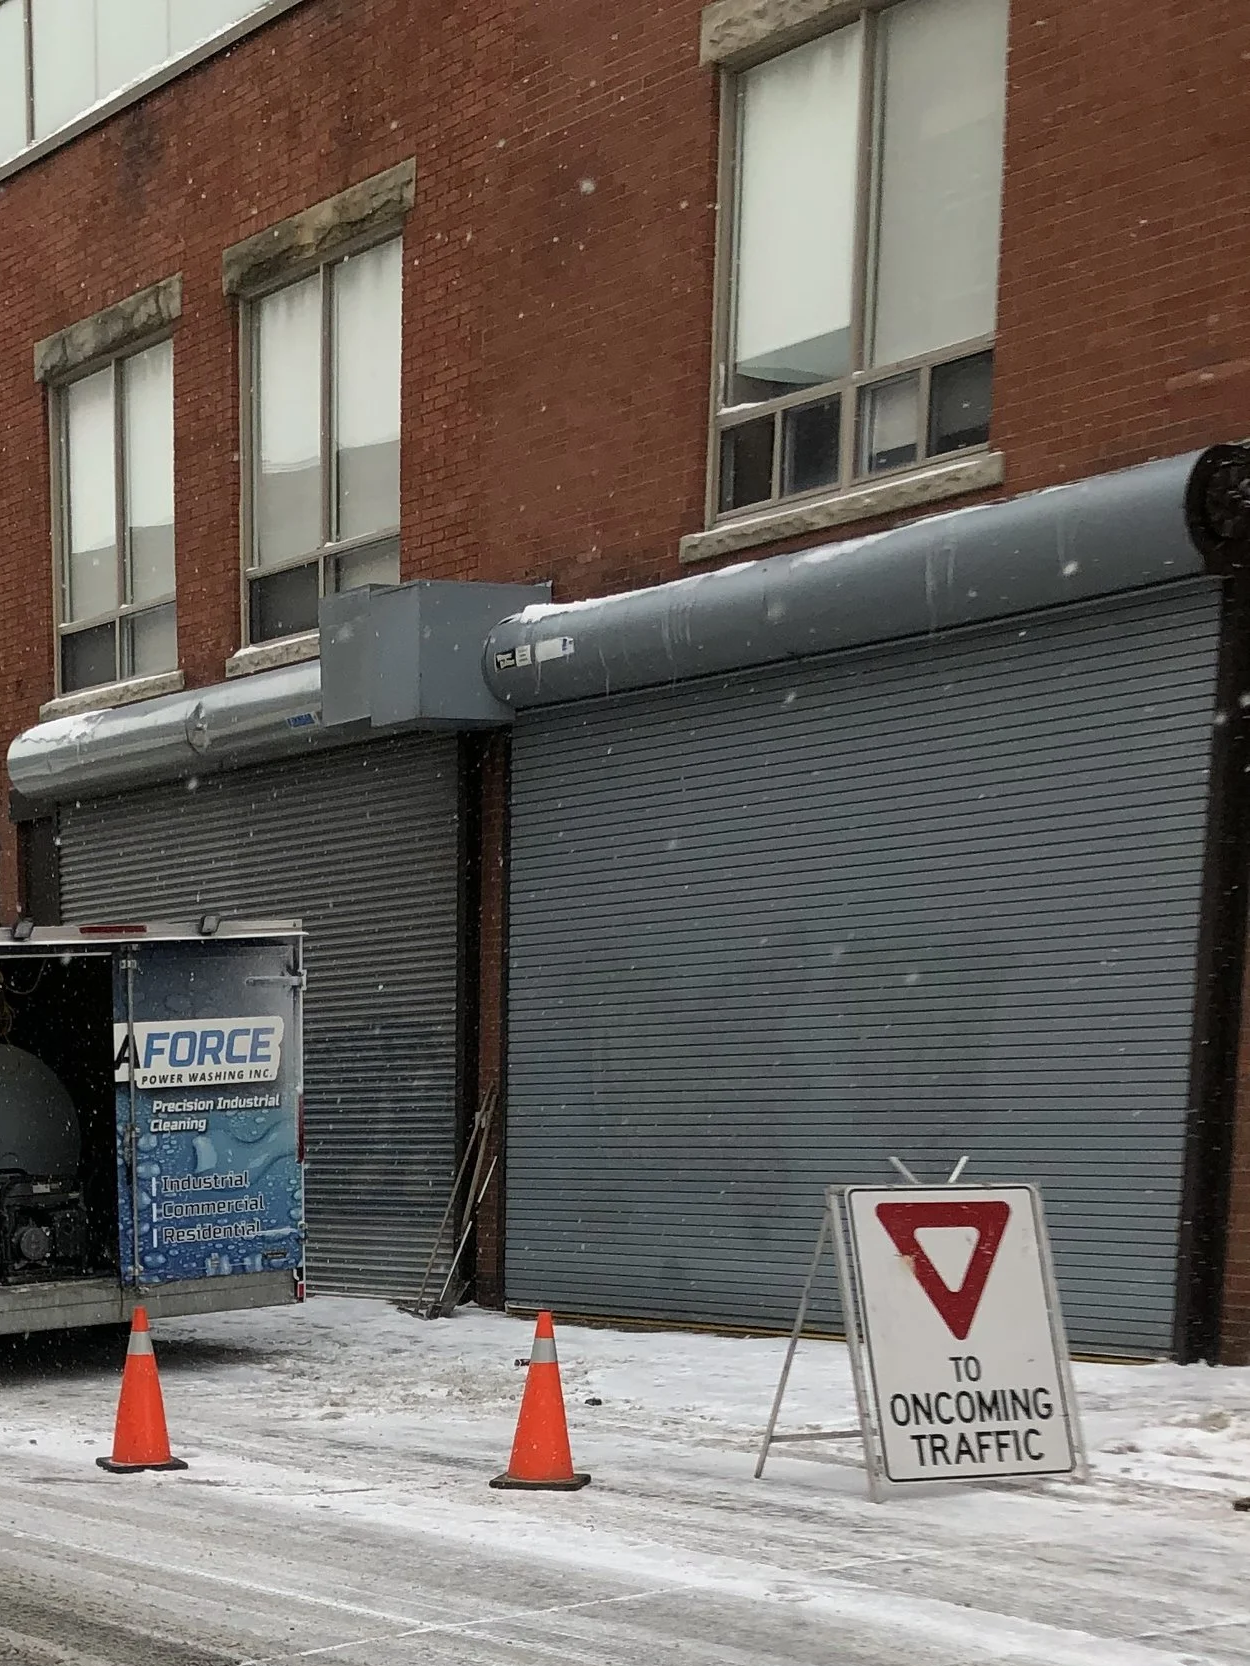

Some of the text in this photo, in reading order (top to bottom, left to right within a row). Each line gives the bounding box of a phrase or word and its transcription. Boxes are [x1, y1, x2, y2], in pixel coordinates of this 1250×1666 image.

[114, 1027, 275, 1070] AFORCE
[141, 1068, 273, 1085] POWER WASHING INC.
[152, 1094, 280, 1114] Precision Industrial
[150, 1117, 207, 1133] Cleaning
[161, 1170, 249, 1193] Industrial
[162, 1194, 265, 1219] Commercial
[163, 1219, 261, 1244] Residential
[948, 1355, 982, 1383] TO
[890, 1387, 1054, 1427] ONCOMING
[910, 1428, 1045, 1466] TRAFFIC
